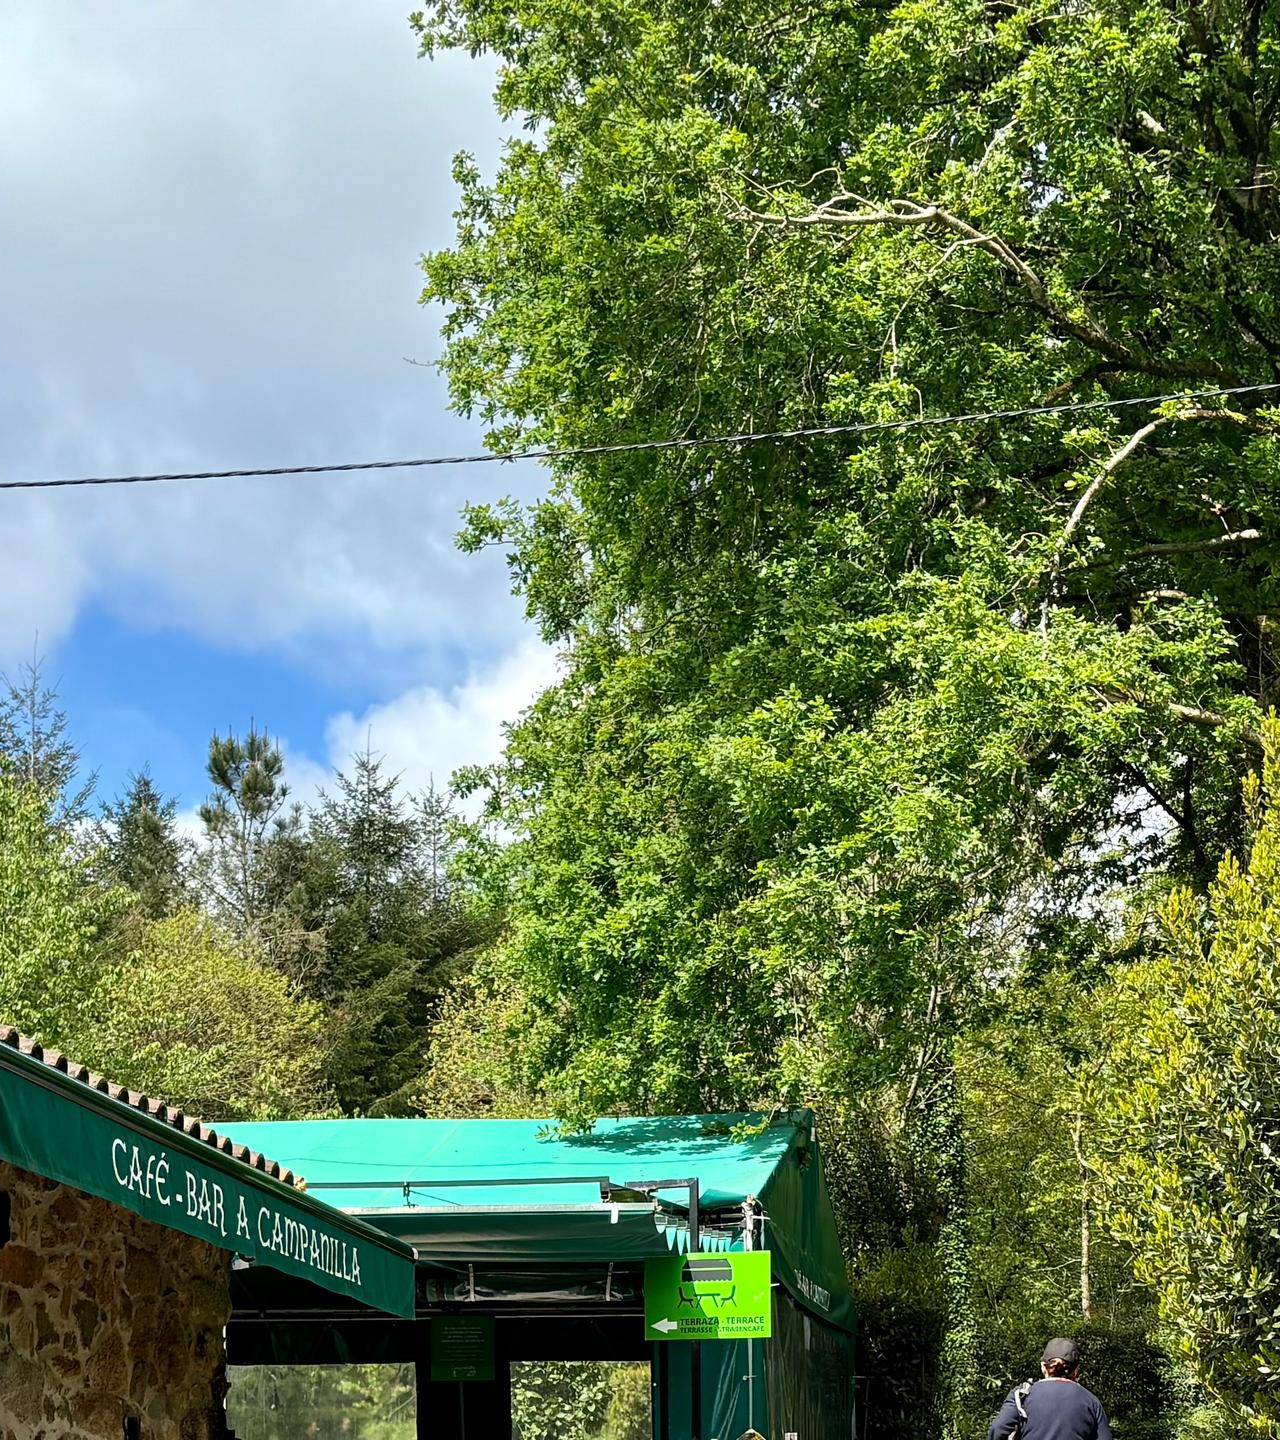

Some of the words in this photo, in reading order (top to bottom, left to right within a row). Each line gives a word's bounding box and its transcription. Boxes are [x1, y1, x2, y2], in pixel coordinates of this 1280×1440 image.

[236, 1195, 251, 1240] A
[257, 1206, 362, 1286] CAMPANILLA
[680, 1317, 720, 1326] TERRAZA
[726, 1316, 765, 1325] TERRACE
